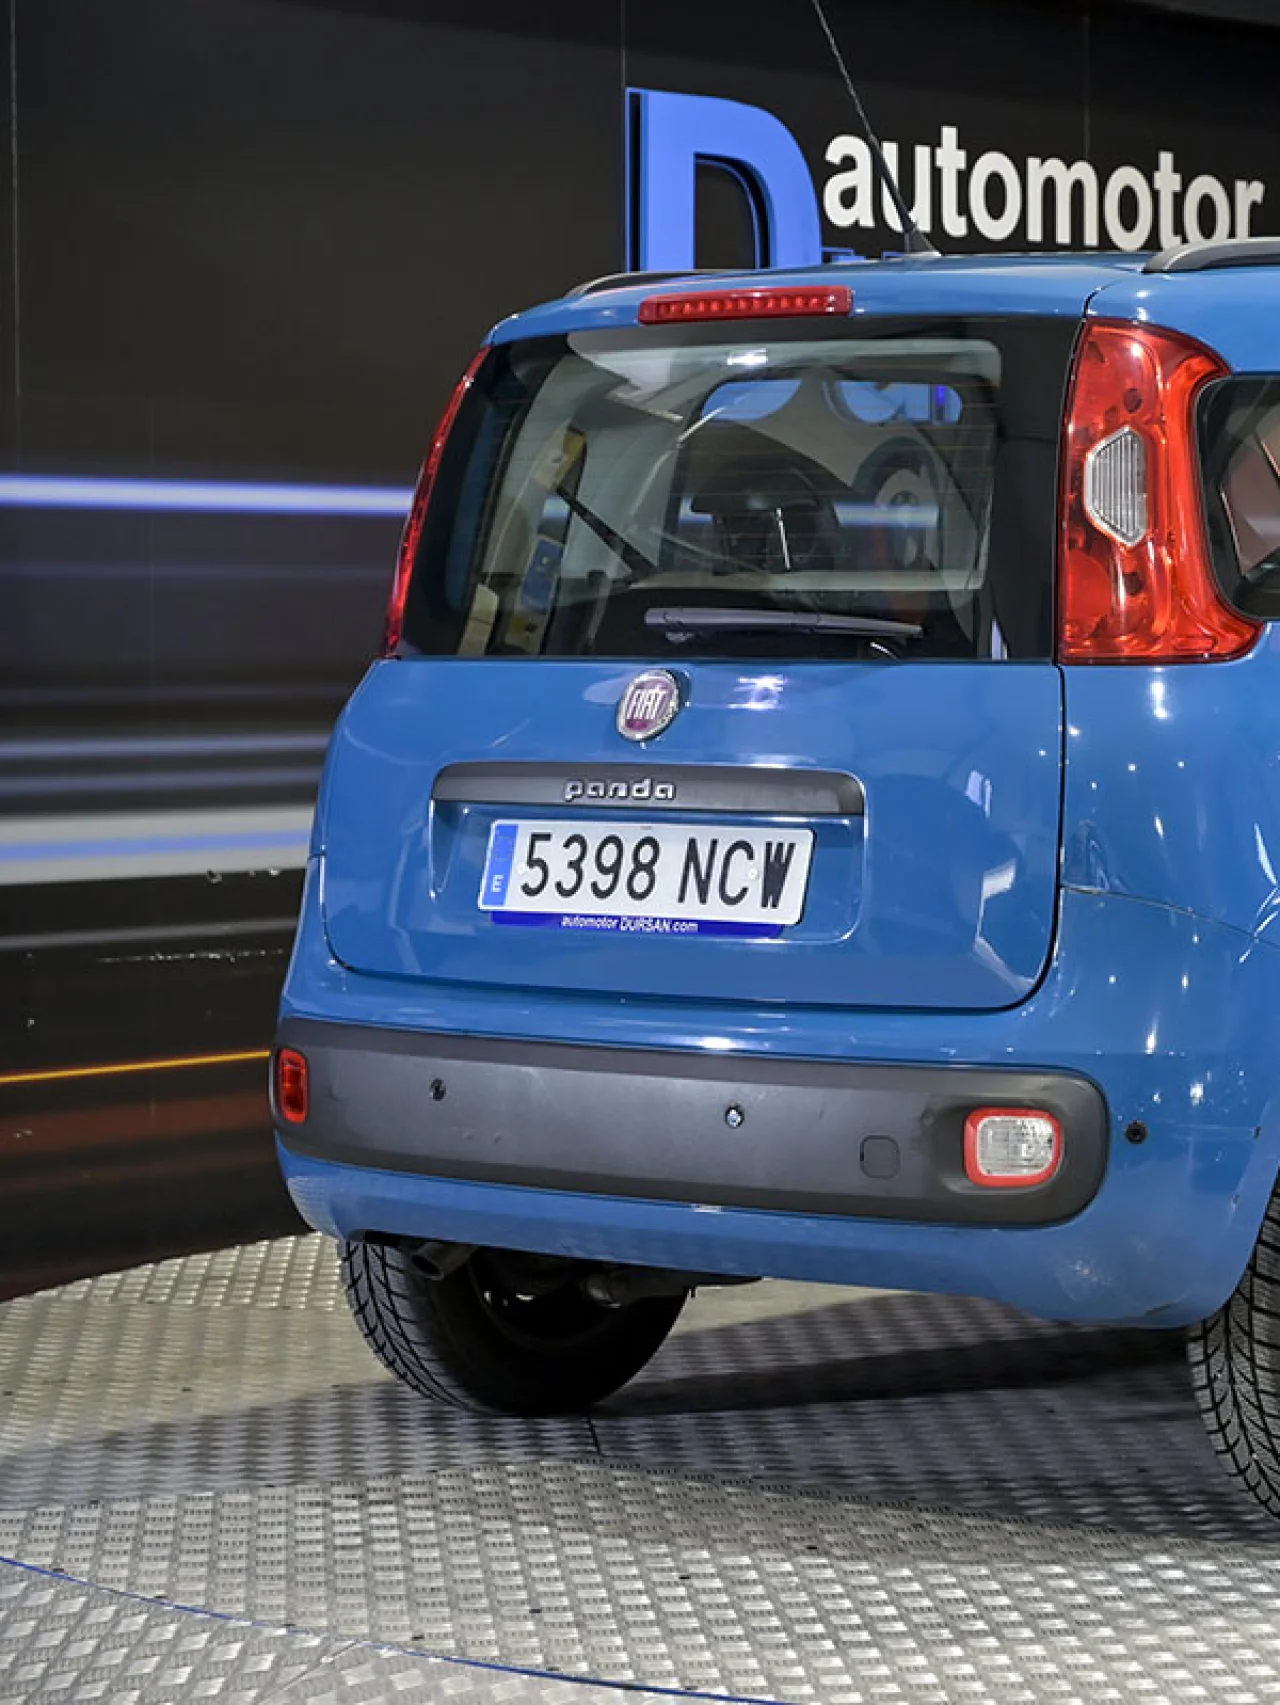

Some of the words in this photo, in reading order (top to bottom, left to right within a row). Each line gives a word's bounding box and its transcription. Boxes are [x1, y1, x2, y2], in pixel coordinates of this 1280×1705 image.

[823, 126, 1265, 251] automotor
[564, 778, 676, 801] panda
[520, 832, 660, 901] 5398
[677, 837, 797, 909] NCW
[490, 874, 504, 893] E
[561, 915, 619, 929] automotor
